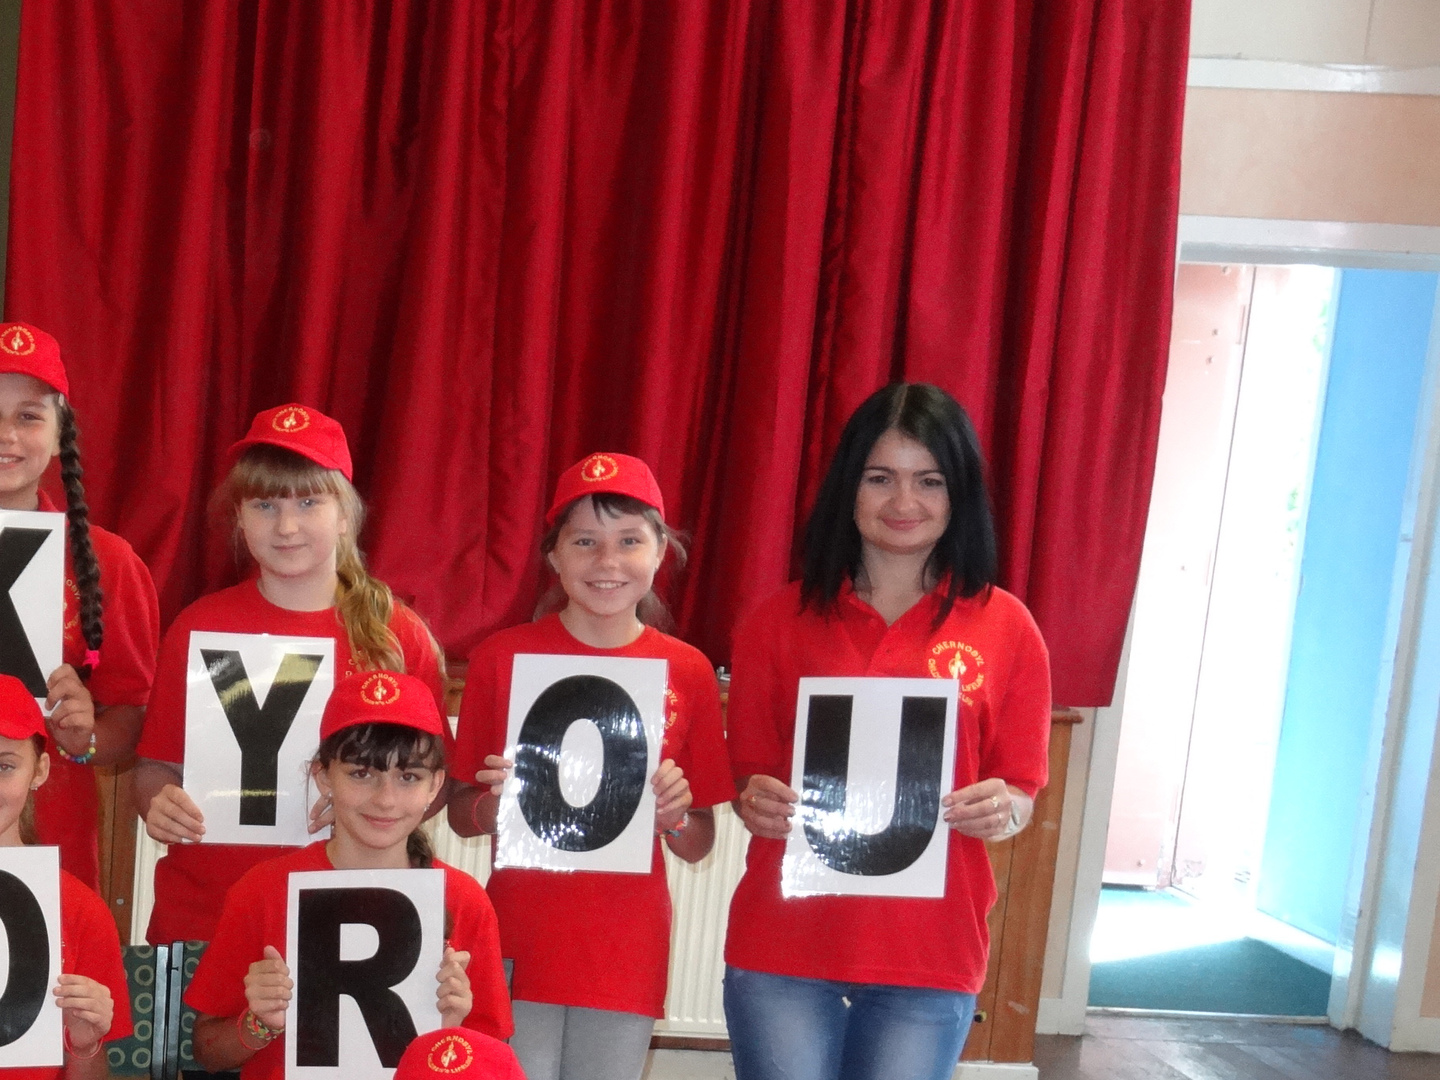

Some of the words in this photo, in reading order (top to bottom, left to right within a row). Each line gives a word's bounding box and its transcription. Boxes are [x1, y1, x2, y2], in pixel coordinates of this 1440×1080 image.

[201, 649, 325, 827] Y
[932, 640, 985, 667] CHERNOBYL
[515, 675, 649, 852] O
[803, 695, 947, 877] U
[296, 887, 423, 1069] R
